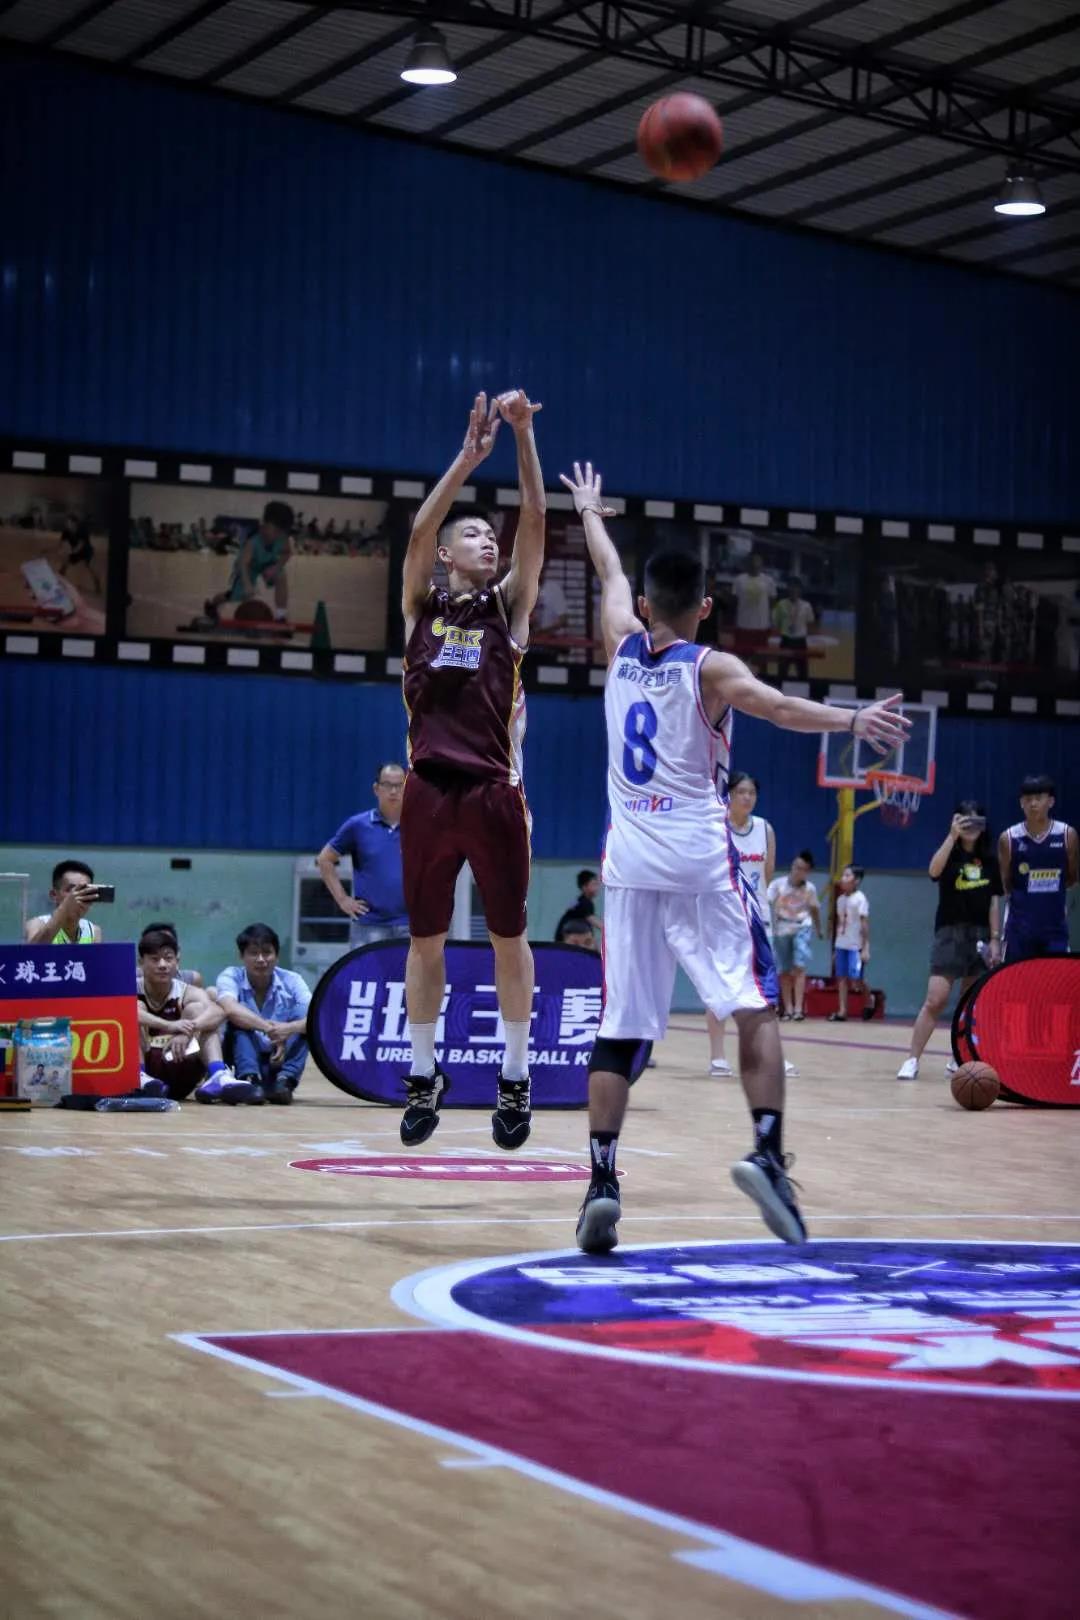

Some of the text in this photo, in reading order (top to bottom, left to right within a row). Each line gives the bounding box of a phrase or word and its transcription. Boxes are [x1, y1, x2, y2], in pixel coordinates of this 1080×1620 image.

[623, 701, 658, 785] 8
[14, 960, 87, 984] 球王酒
[340, 981, 377, 1061] UBK
[375, 1046, 444, 1063] URBN
[447, 1048, 570, 1065] BASKBALL
